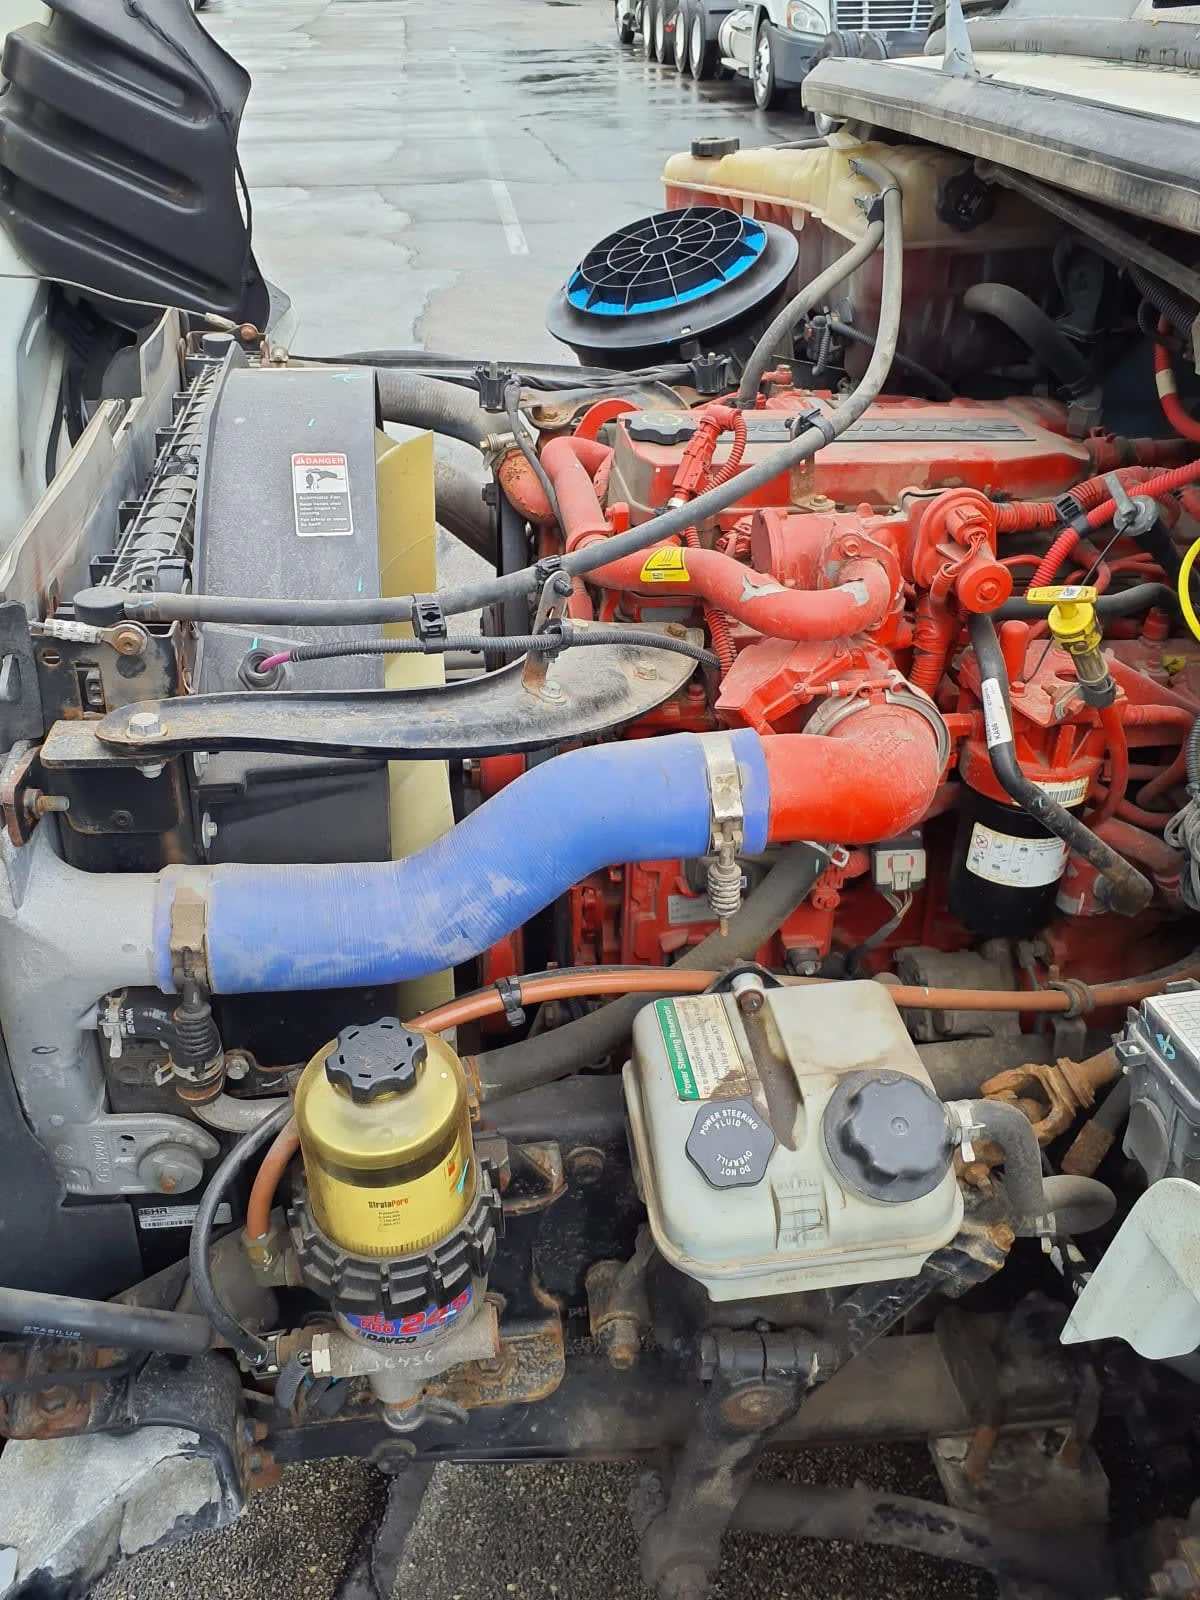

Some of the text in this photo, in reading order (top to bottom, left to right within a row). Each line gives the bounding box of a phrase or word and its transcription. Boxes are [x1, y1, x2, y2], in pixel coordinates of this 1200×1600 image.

[305, 456, 344, 465] DANGER
[663, 1005, 693, 1095] Power Steering Reservoir
[699, 1109, 759, 1136] POWER STEERING
[714, 1118, 741, 1129] FLUID
[716, 1150, 753, 1167] OVERFILL
[720, 1164, 751, 1176] DO NOT
[367, 1198, 409, 1209] StrataPore
[23, 1325, 81, 1337] STABILUS
[365, 1332, 418, 1345] DAVCO
